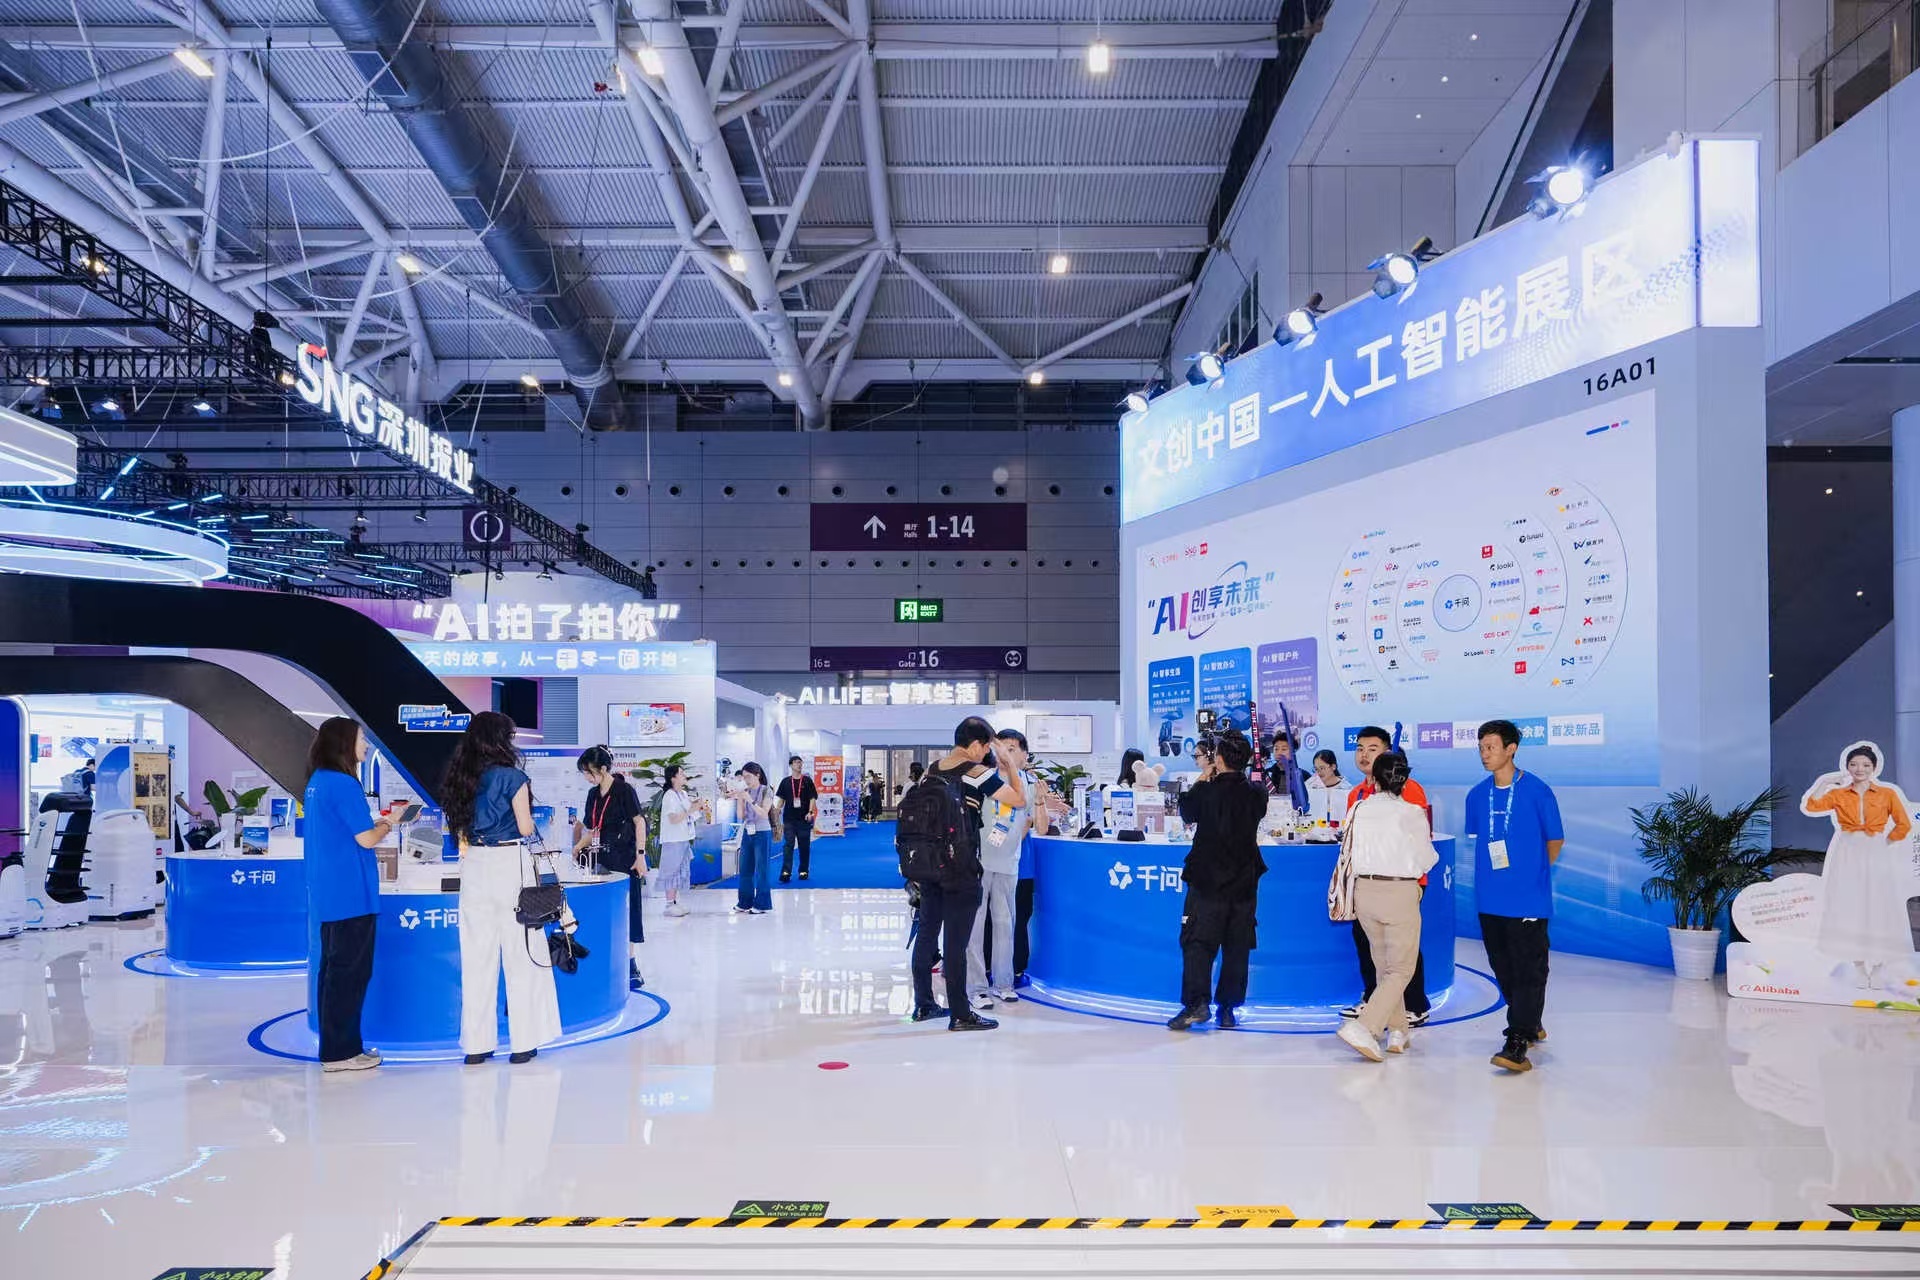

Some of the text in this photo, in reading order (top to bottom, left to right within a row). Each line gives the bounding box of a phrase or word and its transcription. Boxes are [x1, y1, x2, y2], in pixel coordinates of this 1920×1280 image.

[1583, 357, 1656, 396] 16A01
[297, 343, 474, 494] SNG 深圳报业
[927, 515, 975, 538] 1-14
[899, 650, 939, 668] Gate 16
[800, 687, 823, 705] AI
[1518, 726, 1545, 739] 余款
[1551, 723, 1601, 737] 首发新品
[248, 871, 276, 885] 千问
[1136, 865, 1184, 893] 千问
[424, 909, 460, 928] 千问
[1753, 985, 1800, 995] Alibaba
